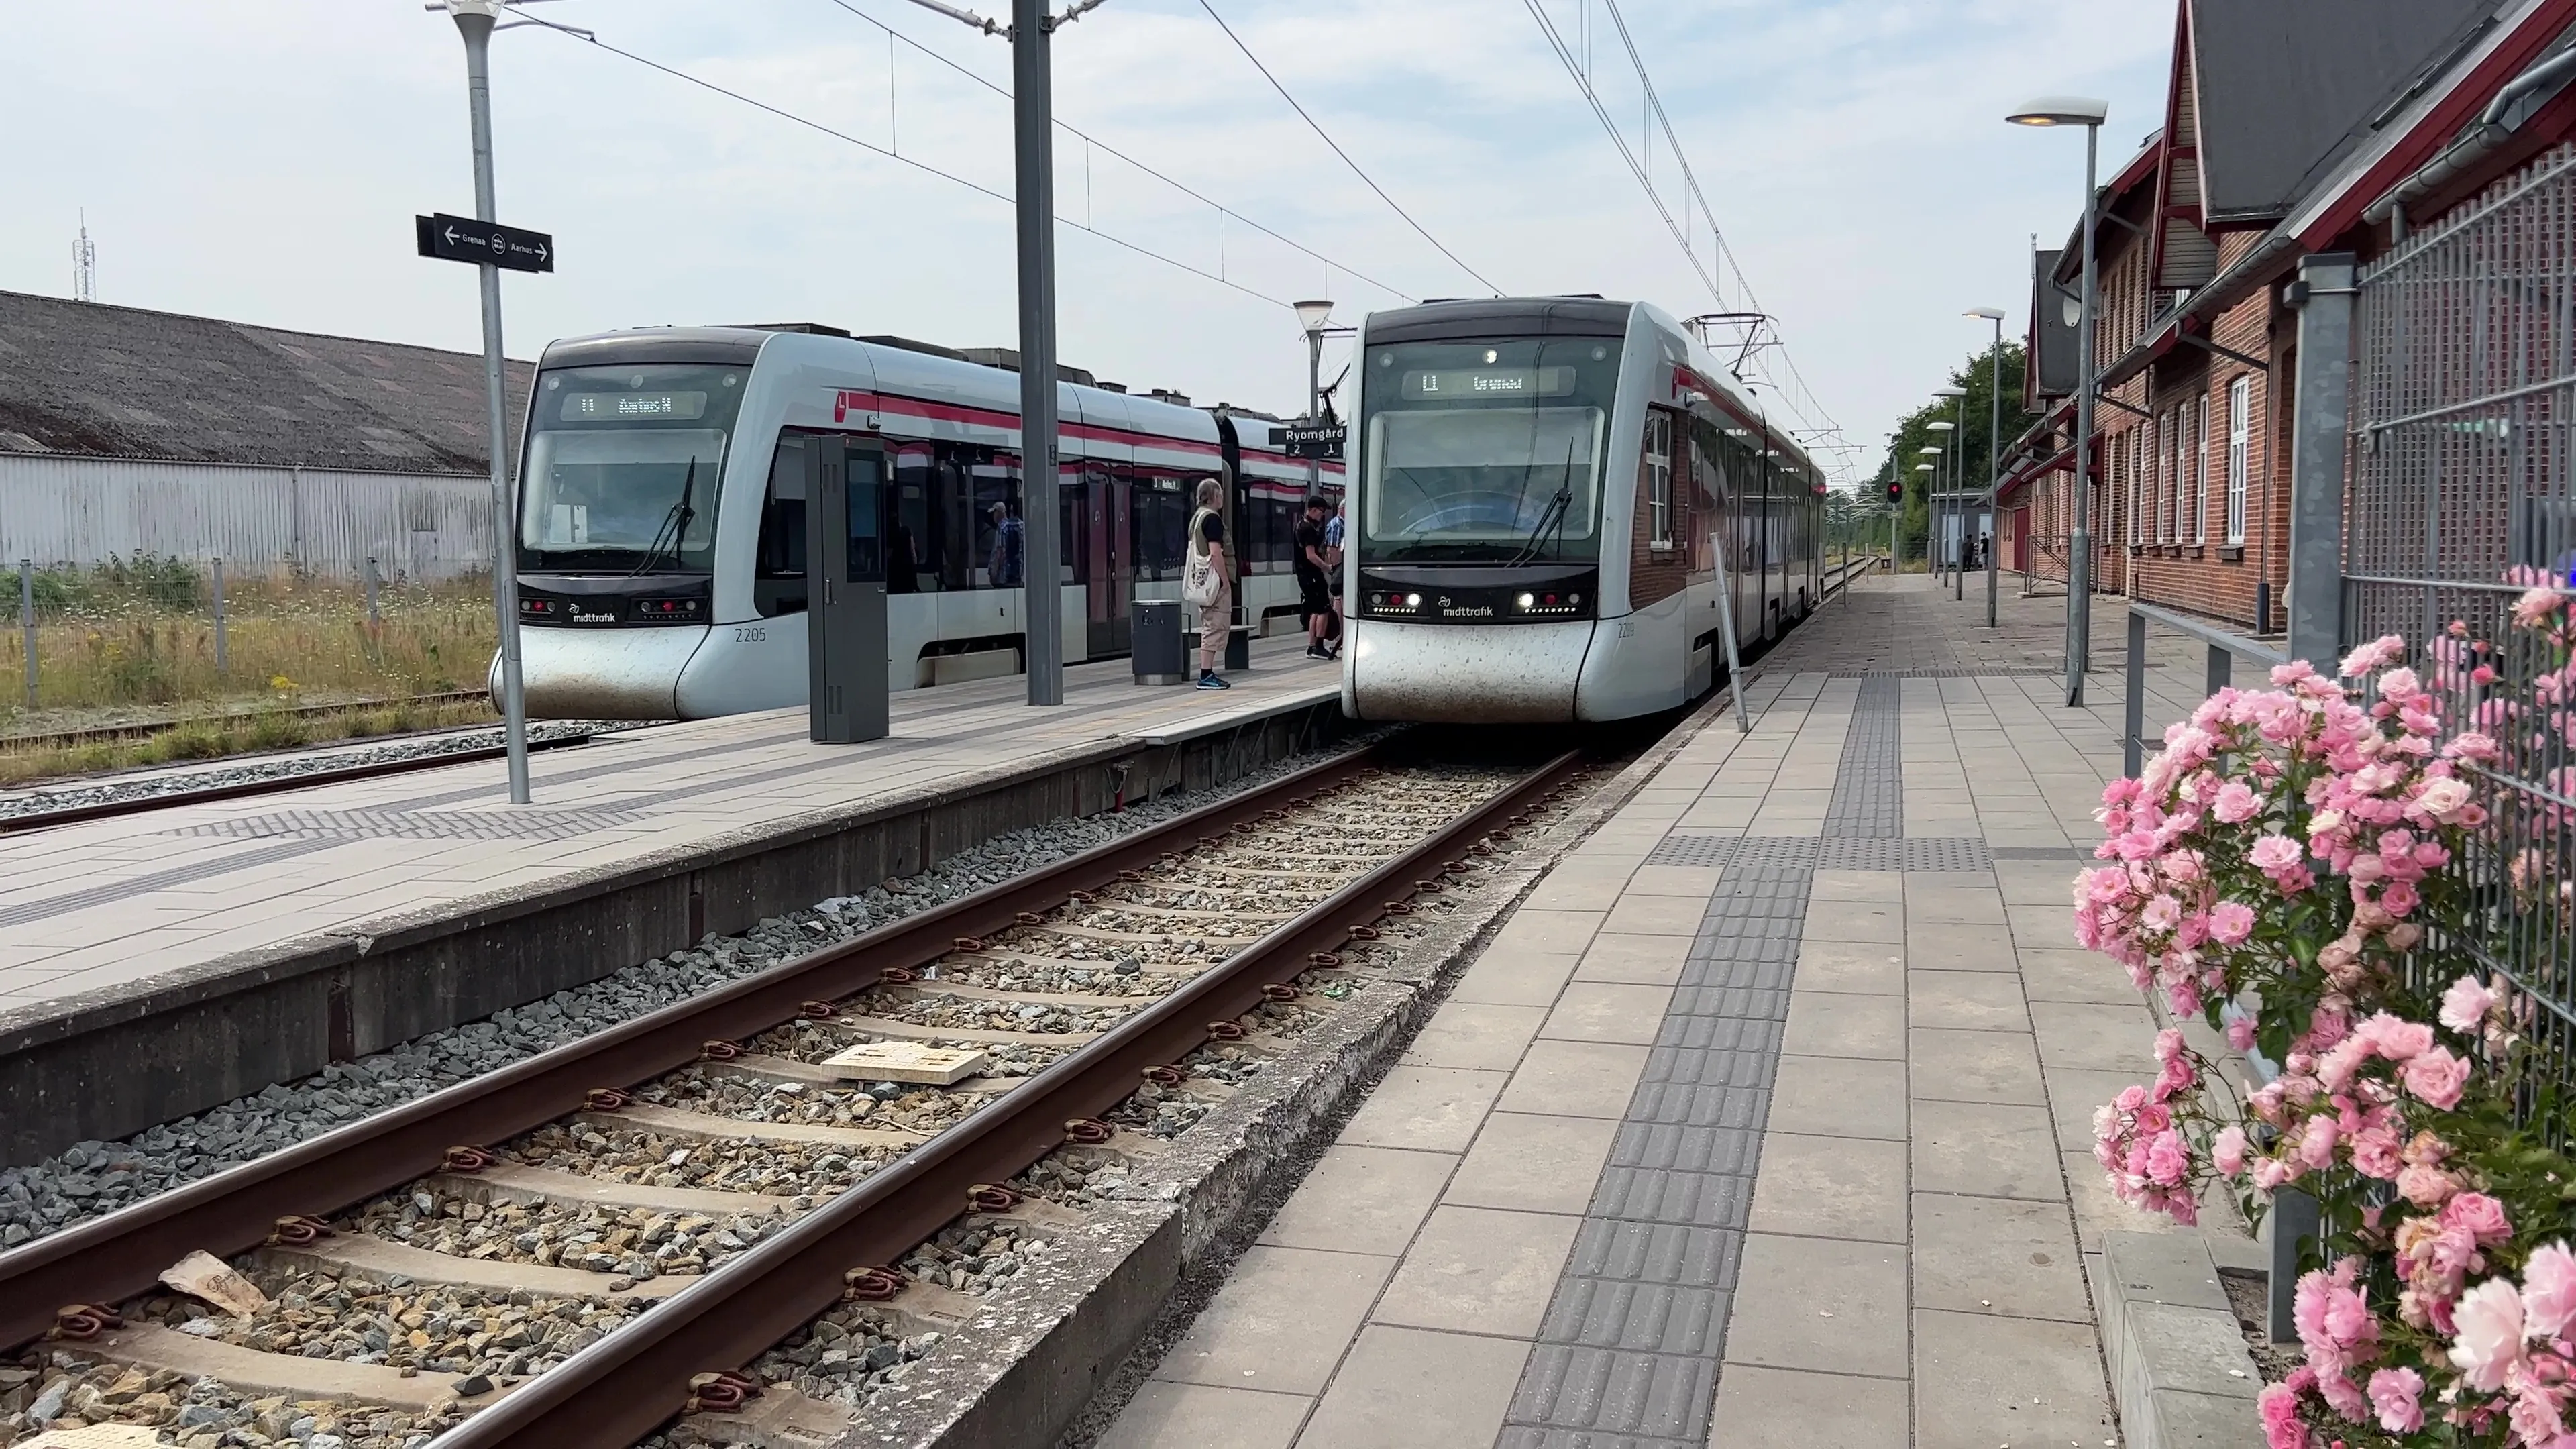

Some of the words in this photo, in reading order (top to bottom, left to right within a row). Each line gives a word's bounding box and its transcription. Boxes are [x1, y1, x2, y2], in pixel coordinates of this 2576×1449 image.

[462, 235, 486, 246] Grenaa
[511, 243, 533, 254] Aarhus
[1286, 428, 1344, 443] Ryomgård
[1294, 444, 1301, 454] 2
[1328, 443, 1334, 454] 1
[1443, 606, 1493, 616] midttrafik
[573, 613, 616, 623] midttrafik
[735, 628, 766, 642] 2205
